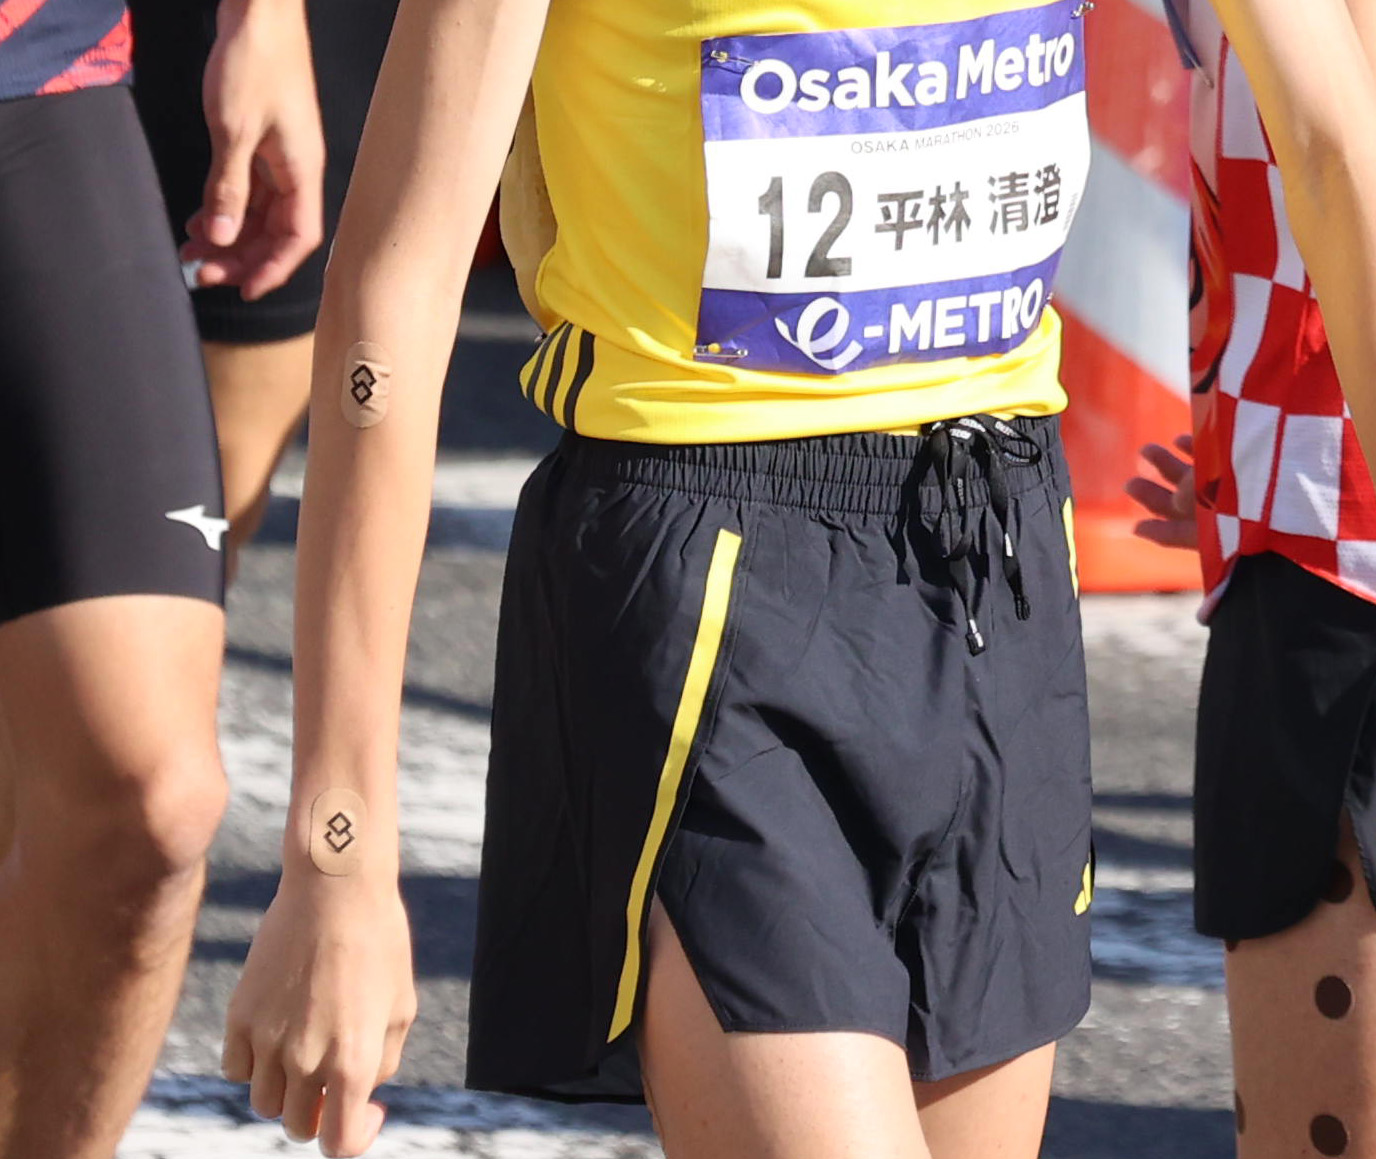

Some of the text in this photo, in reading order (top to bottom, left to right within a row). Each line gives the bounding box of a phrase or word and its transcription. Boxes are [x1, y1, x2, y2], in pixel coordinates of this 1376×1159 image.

[740, 32, 1075, 114] Osaka Metro
[850, 120, 1020, 154] OSAKA MARATHON 2026
[758, 163, 1062, 279] 12 平林 清澄
